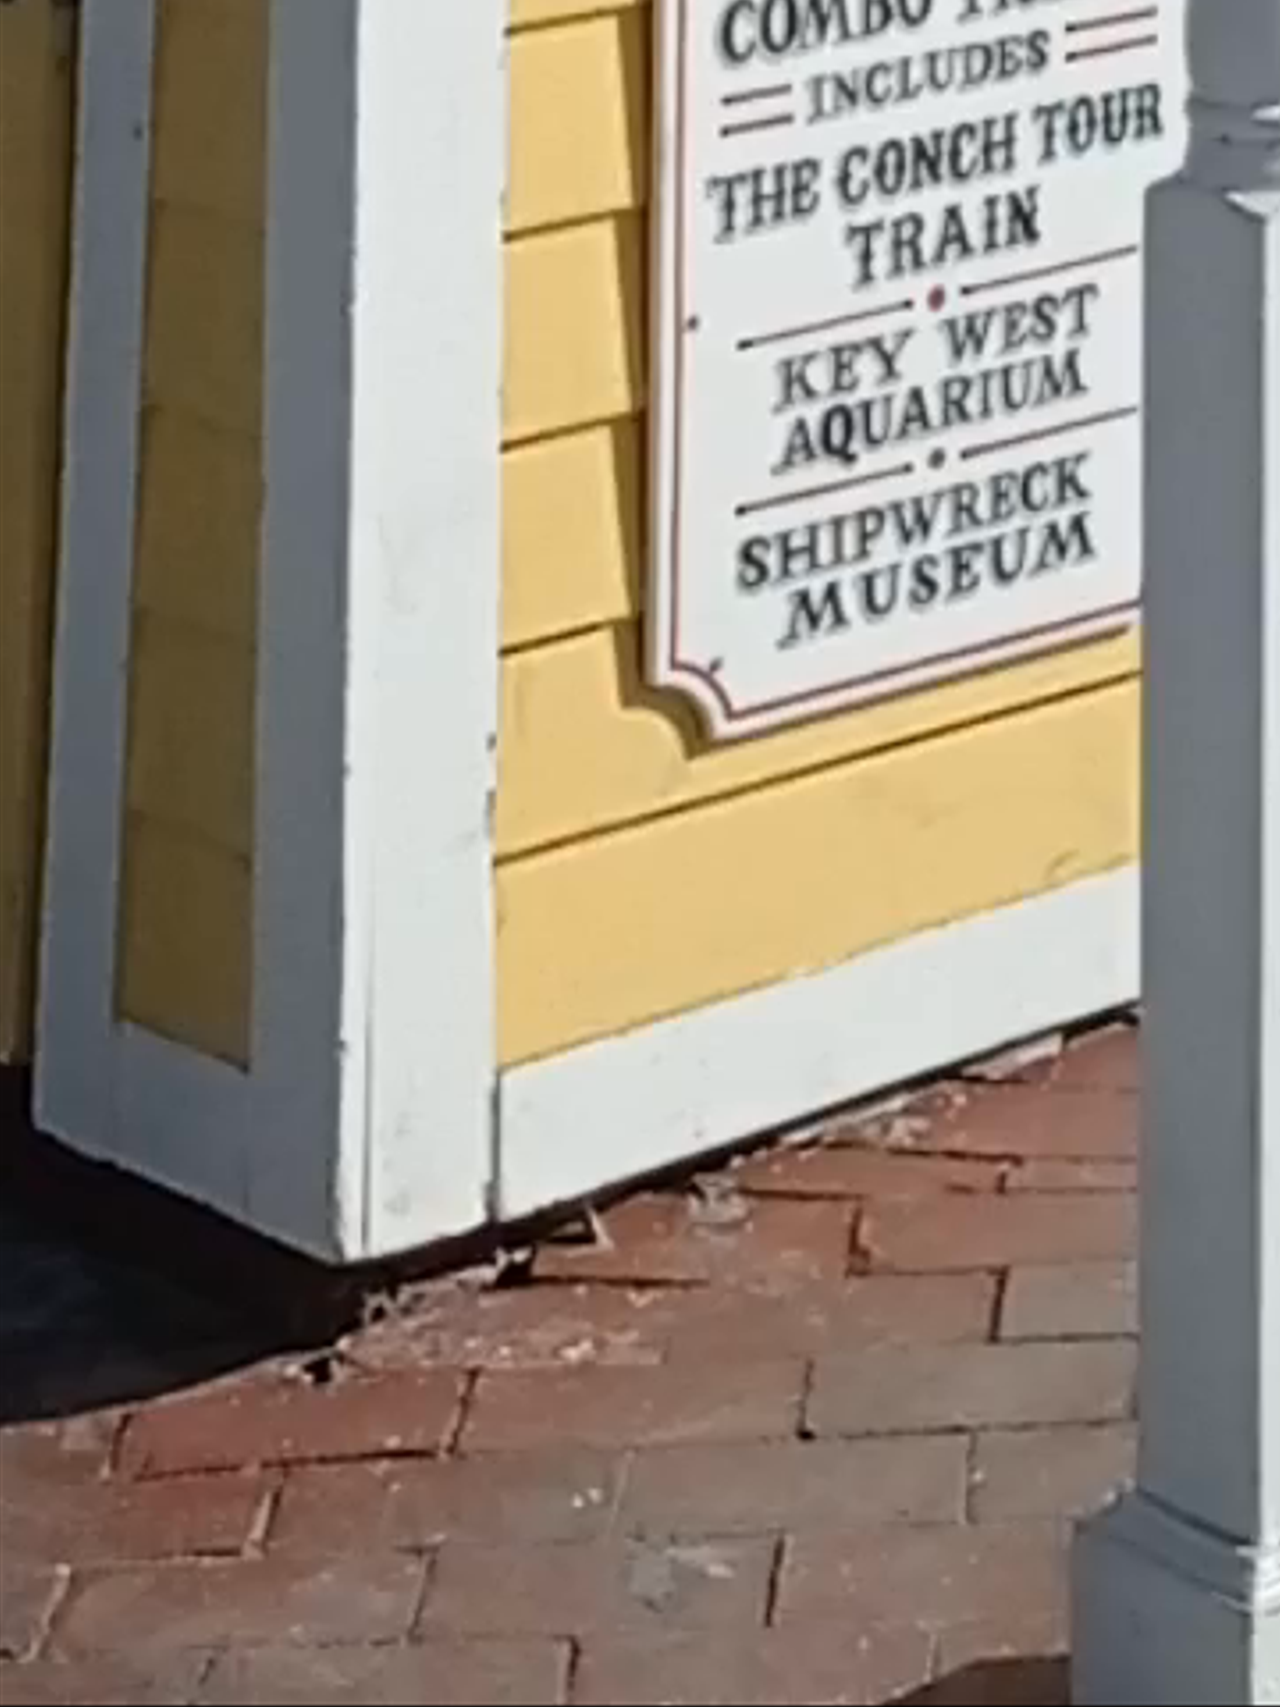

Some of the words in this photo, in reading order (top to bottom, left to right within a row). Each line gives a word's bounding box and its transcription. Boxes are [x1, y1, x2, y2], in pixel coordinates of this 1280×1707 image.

[806, 29, 1050, 126] INCLUDES
[706, 158, 820, 245] THE
[838, 112, 1018, 206] CONCH
[1032, 83, 1164, 167] TOUR
[845, 185, 1041, 291] TRAIN
[770, 348, 1088, 477] AQUARIUM
[771, 328, 916, 414] KEY
[940, 282, 1099, 364] WEST
[735, 450, 1092, 592] SHIPWRECK
[776, 511, 1096, 651] MUSEUM
